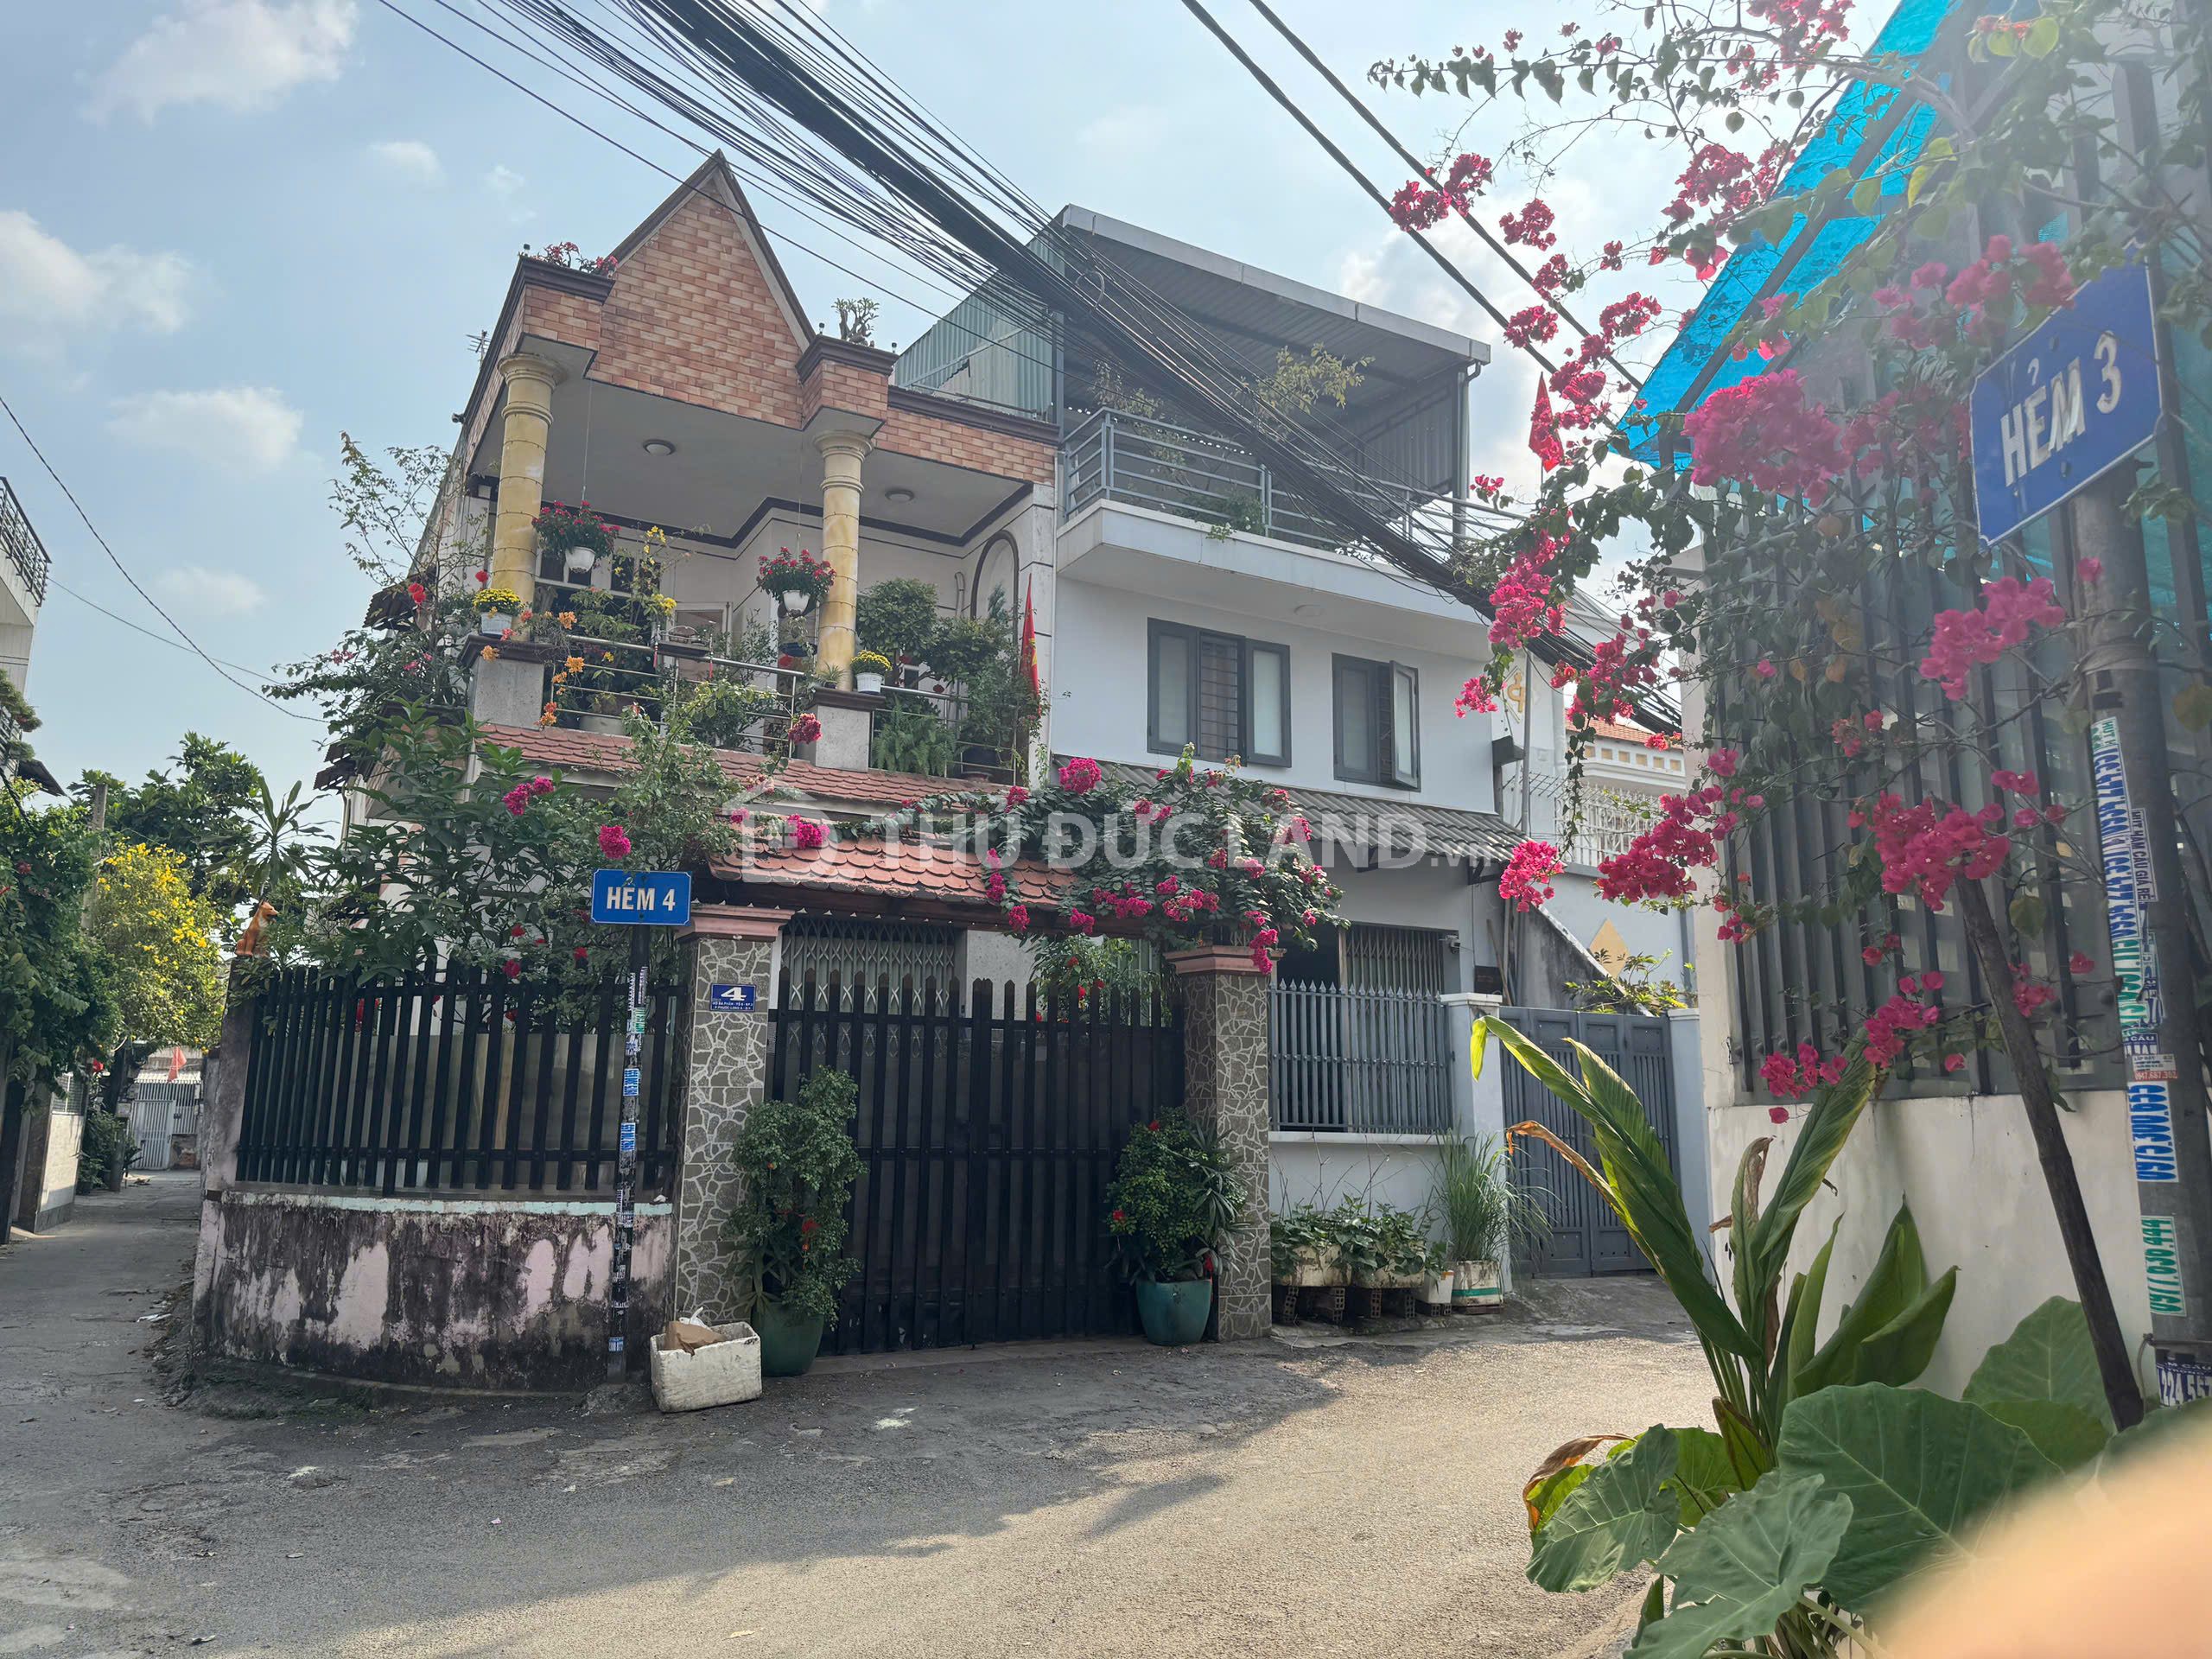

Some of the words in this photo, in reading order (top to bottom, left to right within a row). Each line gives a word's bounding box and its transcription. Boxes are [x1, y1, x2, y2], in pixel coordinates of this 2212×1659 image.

[2000, 357, 2086, 487] HẺM
[2094, 330, 2122, 415] 3
[606, 876, 655, 911] HẺM
[662, 888, 676, 912] 4
[721, 987, 747, 1001] 4
